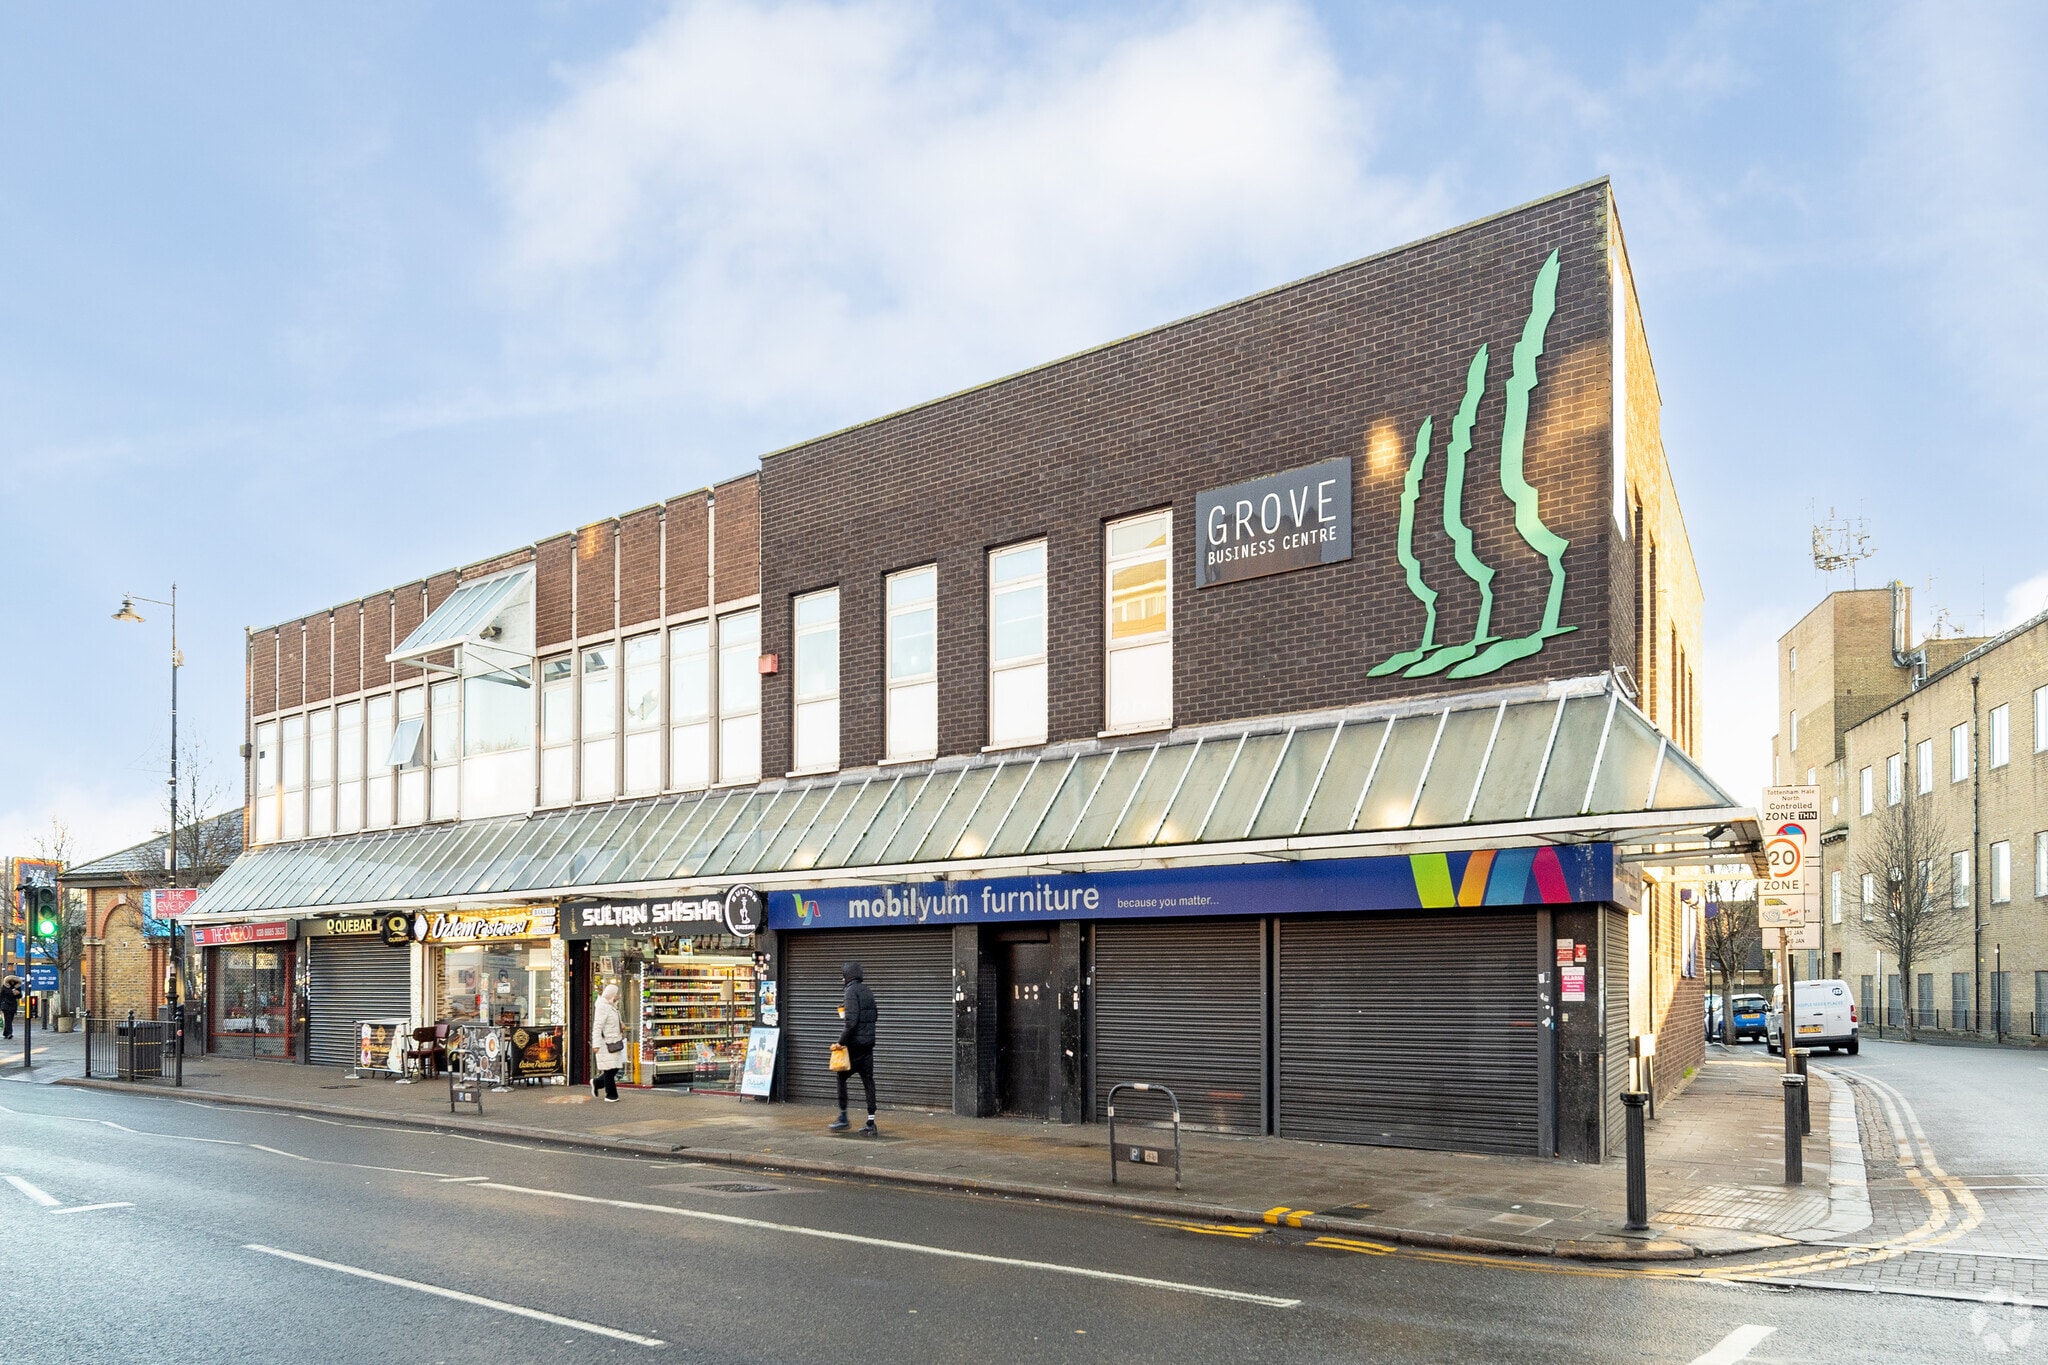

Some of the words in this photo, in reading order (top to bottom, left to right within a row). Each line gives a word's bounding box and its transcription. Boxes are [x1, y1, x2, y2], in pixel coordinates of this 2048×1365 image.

[1208, 479, 1336, 545] GROVE
[1208, 538, 1276, 566] BUSINESS
[1282, 525, 1337, 550] CENTRE
[1769, 802, 1812, 810] Controlled
[1765, 811, 1795, 820] ZONE
[1769, 850, 1795, 865] 20
[1763, 880, 1799, 890] ZONE
[166, 890, 186, 900] THE
[731, 888, 758, 903] SULTAN
[849, 887, 969, 921] mobilyum
[981, 883, 1099, 914] furniture
[1117, 898, 1157, 908] because
[1159, 898, 1177, 909] you
[1178, 896, 1220, 906] matter...
[157, 901, 177, 911] EYE
[178, 901, 193, 910] PO
[581, 902, 648, 928] SULTAN
[651, 899, 723, 923] SHISHA
[335, 918, 372, 933] QUEBAR
[432, 913, 477, 939] Özlem
[211, 927, 225, 943] THE
[224, 926, 240, 942] EYE
[239, 925, 254, 940] POD
